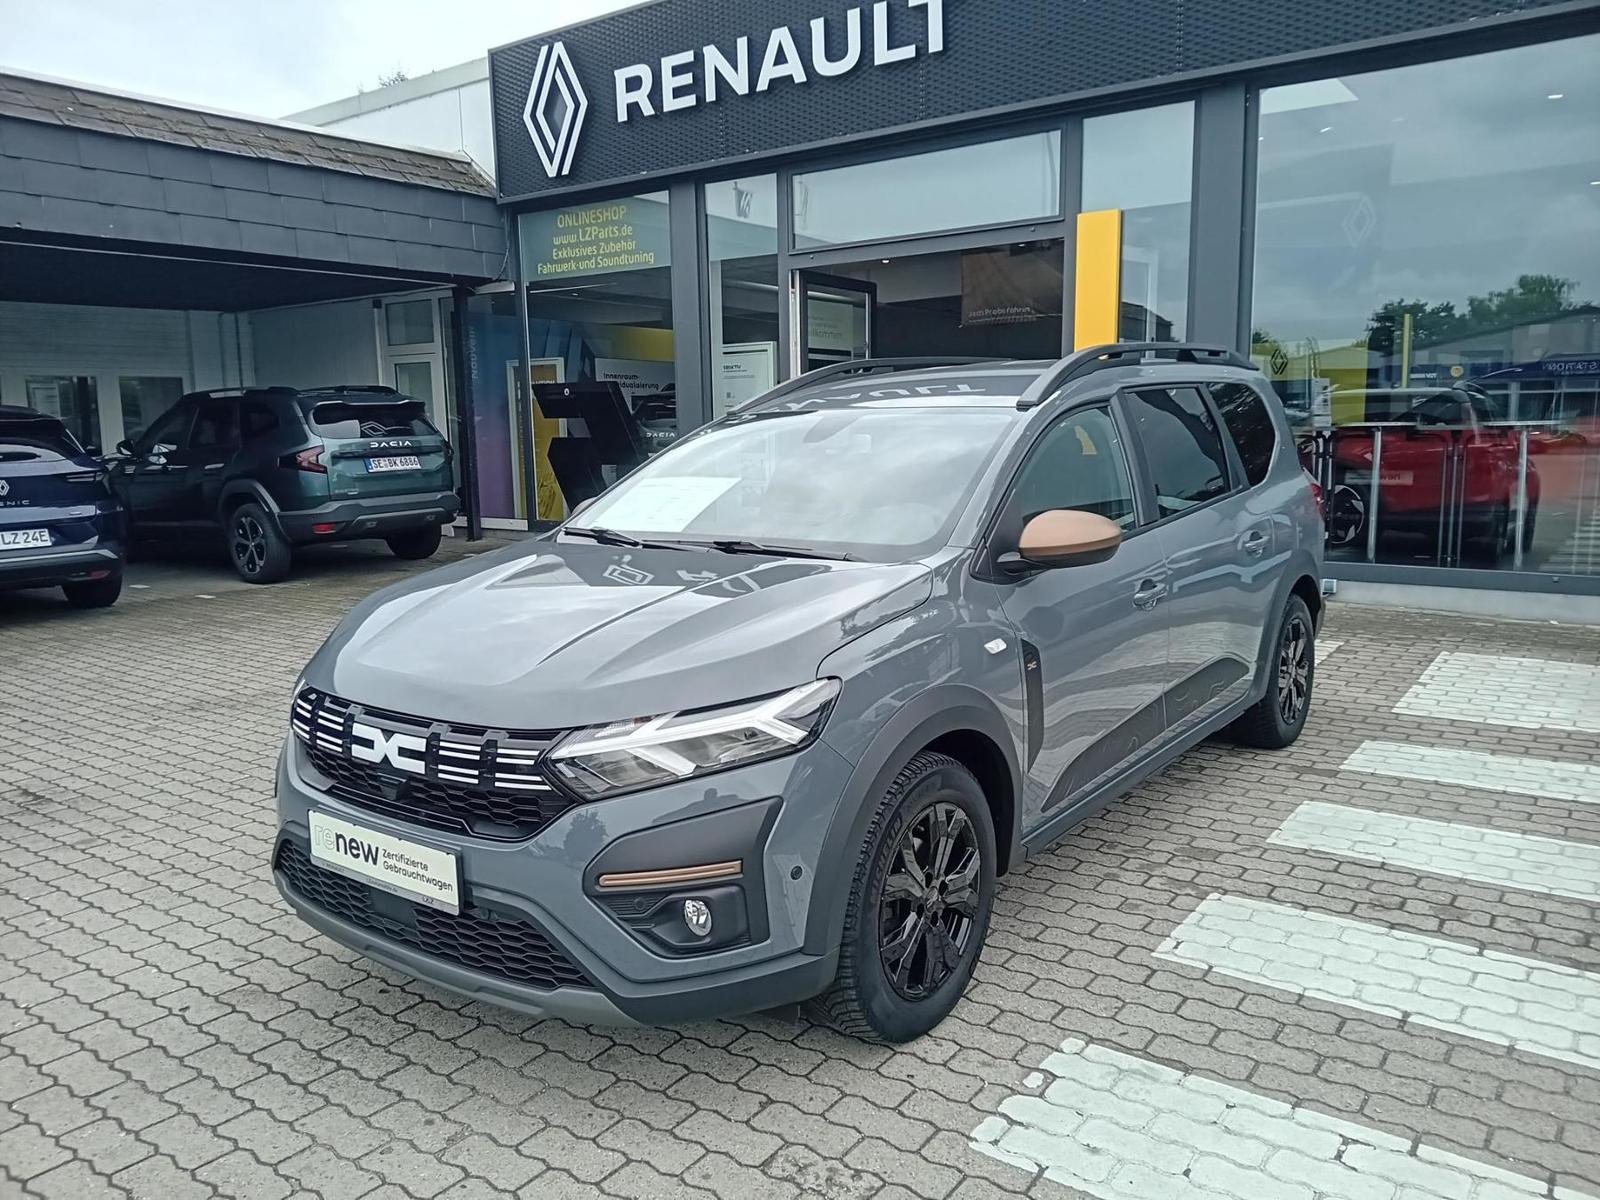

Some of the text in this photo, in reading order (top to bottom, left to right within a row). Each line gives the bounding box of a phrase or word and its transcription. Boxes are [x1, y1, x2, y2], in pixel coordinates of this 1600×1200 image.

[613, 0, 945, 123] RENAULT
[557, 205, 627, 228] ONLINESHOP
[553, 224, 633, 245] www.LZParts.de
[552, 239, 637, 260] Exklusives Zubehör
[597, 251, 655, 268] Soundtuning
[620, 380, 660, 391] idualisierung
[370, 440, 412, 448] DACIA
[372, 459, 384, 469] SE
[0, 530, 49, 545] LZ 24E
[382, 848, 429, 872] Zertifizierte
[383, 860, 453, 892] Gebrauchtwagen
